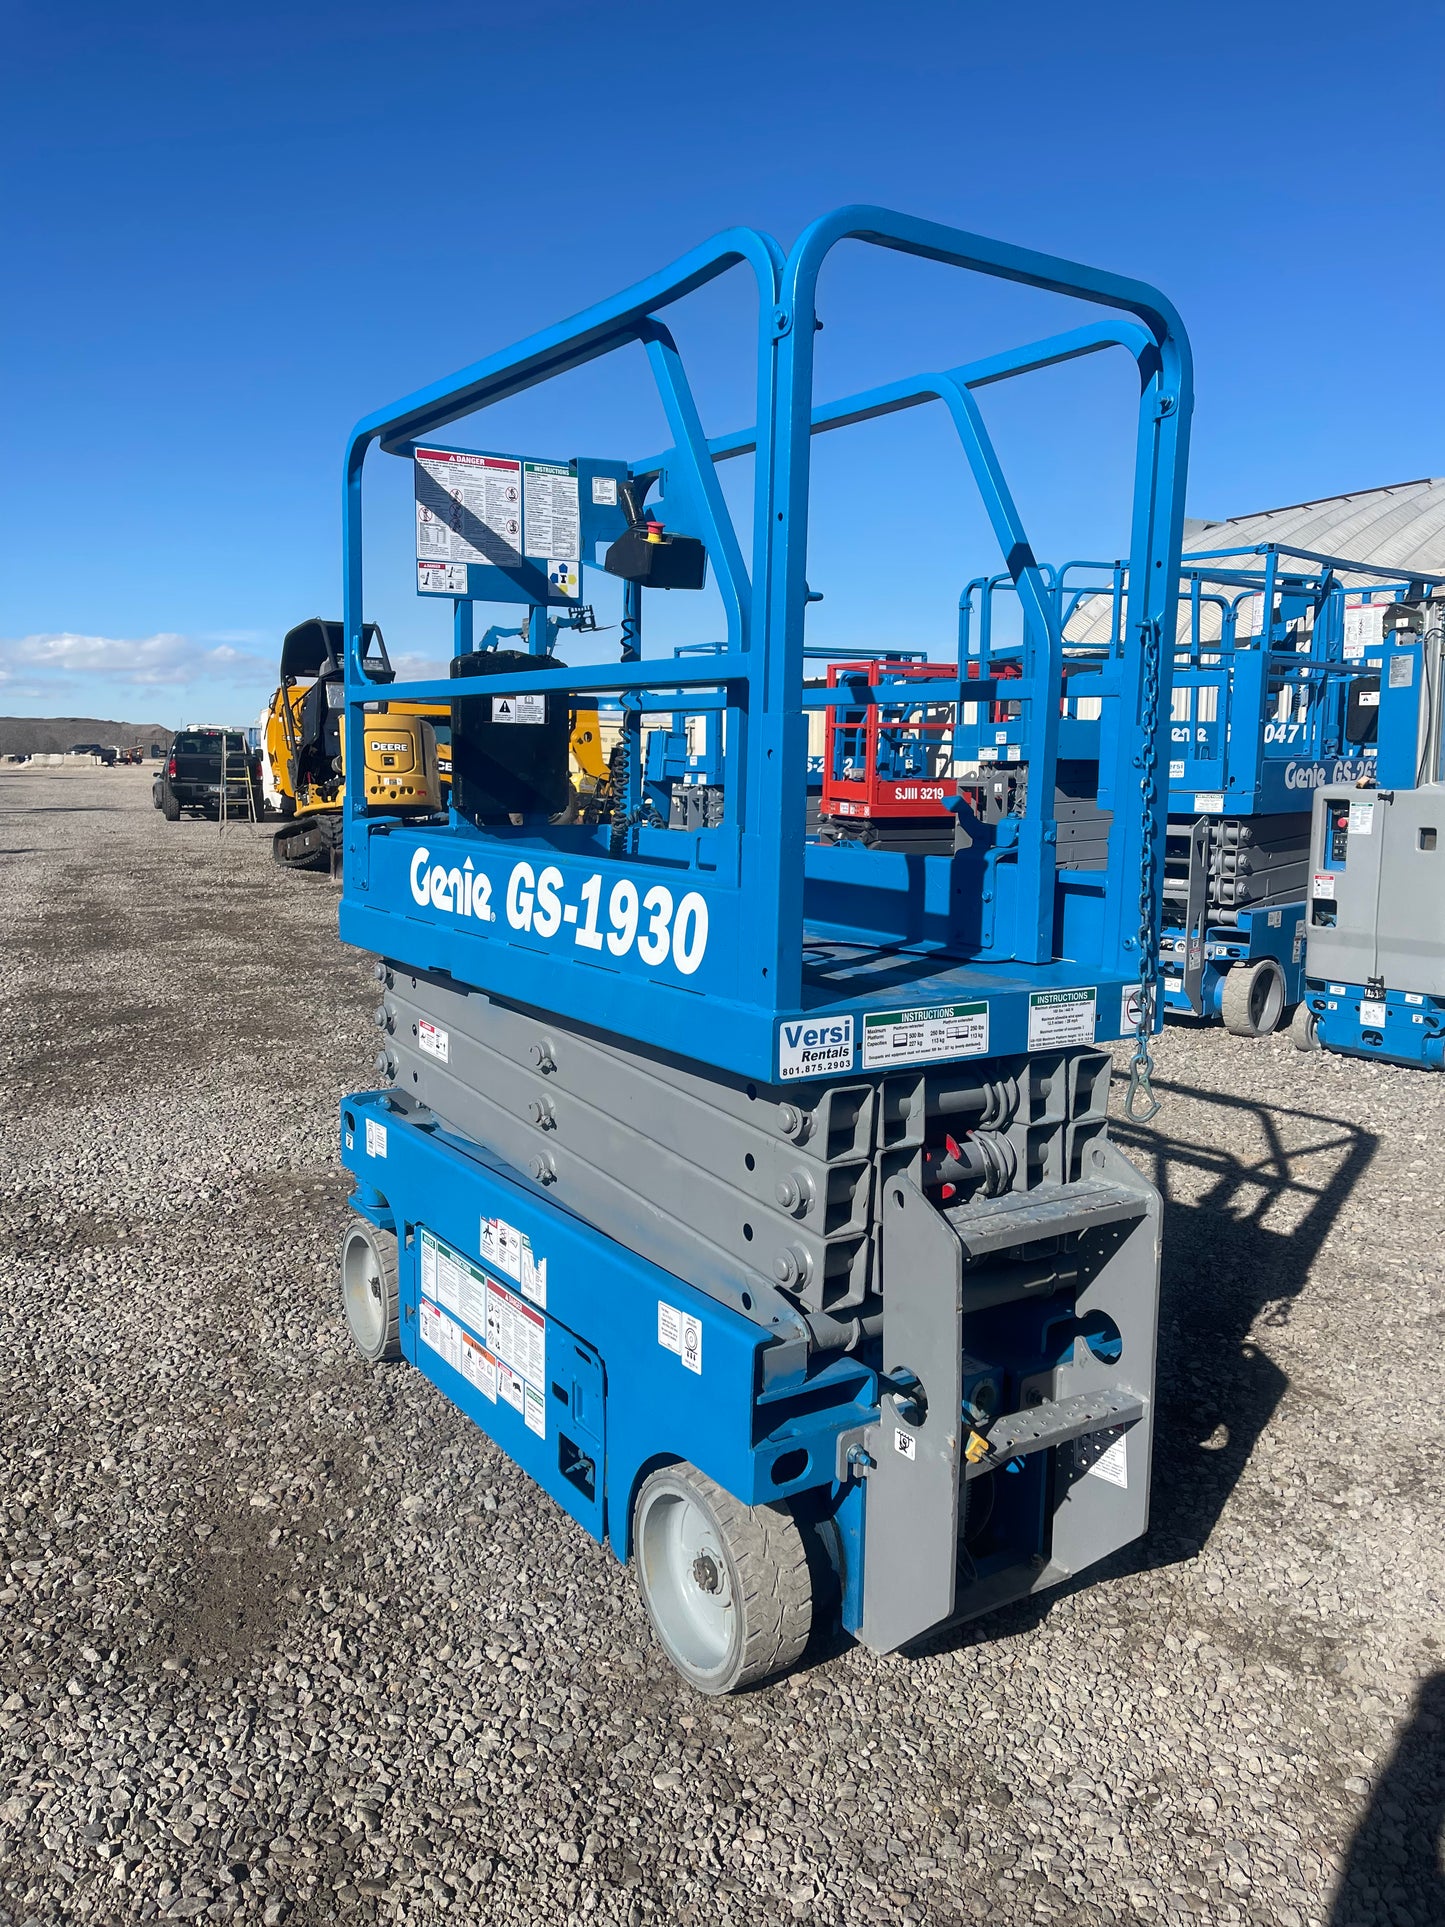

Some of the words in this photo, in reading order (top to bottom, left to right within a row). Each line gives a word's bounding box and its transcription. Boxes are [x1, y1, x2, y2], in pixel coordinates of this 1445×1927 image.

[456, 456, 485, 466] DANGER
[534, 466, 570, 476] INSTRUCTIONS
[371, 741, 408, 752] DEERE
[1285, 762, 1326, 790] Genie
[895, 788, 918, 800] SJIII
[920, 788, 944, 800] 3219
[410, 847, 492, 922] Genie
[506, 861, 709, 975] GS-1930
[1037, 992, 1088, 1004] INSTRUCTIONS
[902, 1008, 954, 1022] INSTRUCTIONS
[784, 1020, 850, 1048] Versi
[802, 1046, 850, 1062] Rentals
[782, 1060, 851, 1076] 801.875.2903
